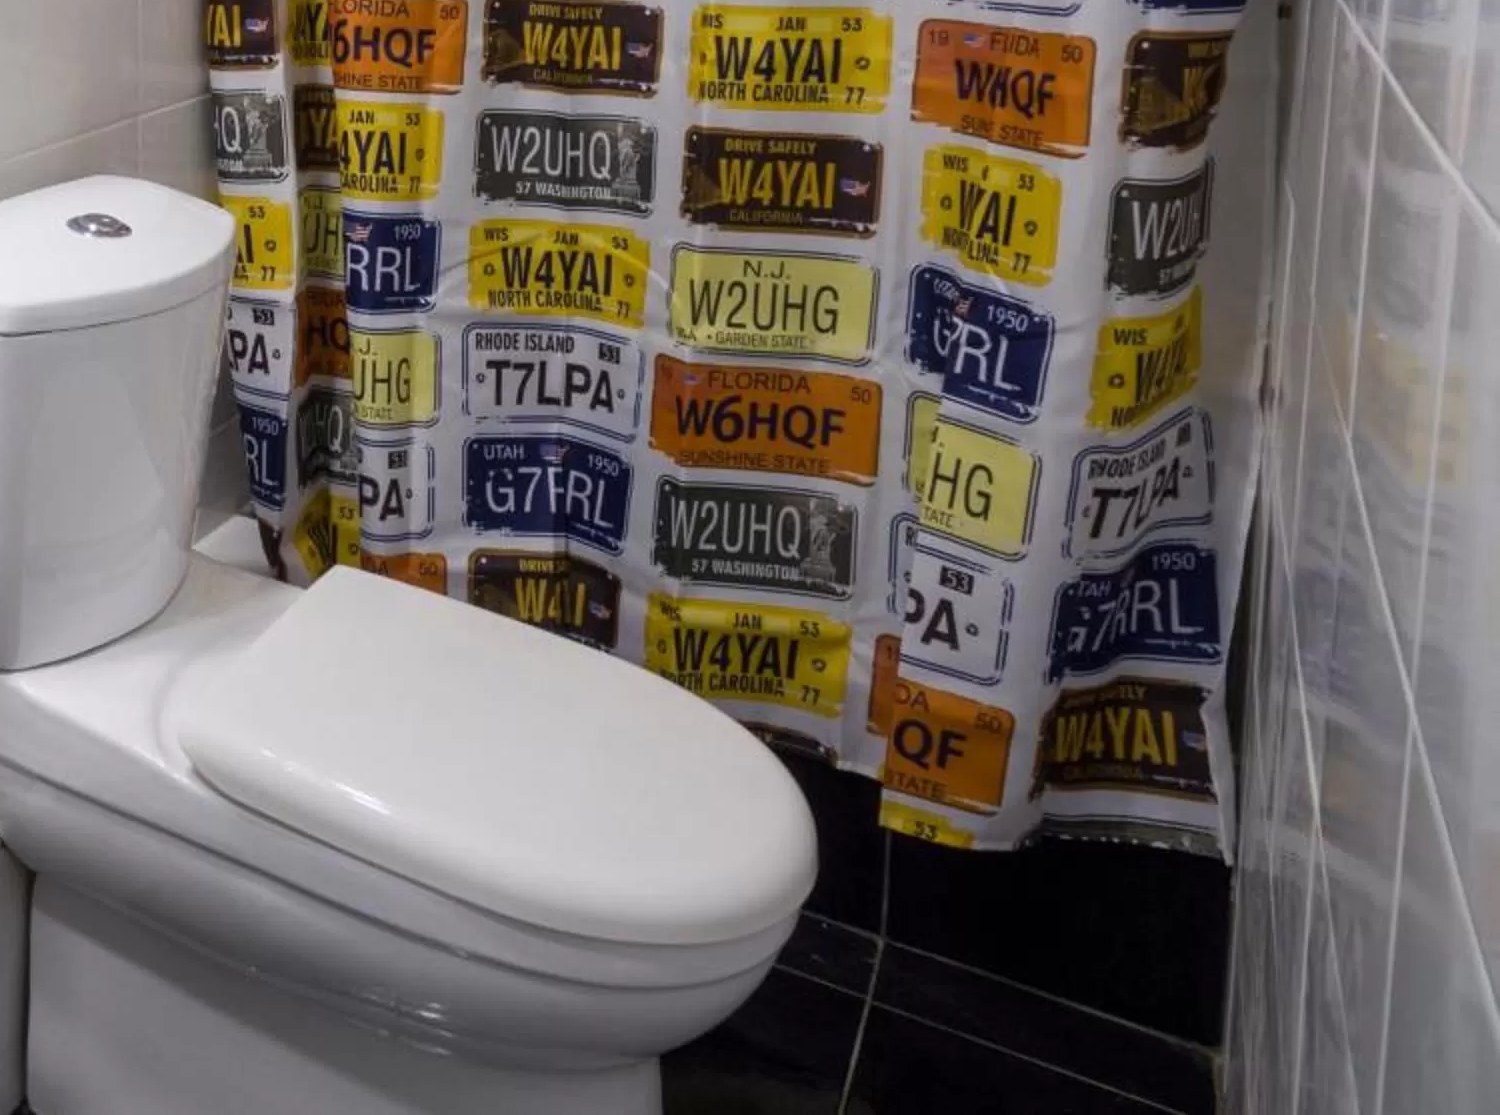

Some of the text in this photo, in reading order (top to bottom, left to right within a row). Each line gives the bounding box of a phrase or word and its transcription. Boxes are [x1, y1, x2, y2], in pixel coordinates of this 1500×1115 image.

[439, 4, 460, 22] 50
[775, 15, 863, 32] JAN 53
[522, 20, 622, 66] W4YAI
[1059, 42, 1084, 63] 50
[713, 35, 843, 86] W4YAI
[378, 75, 425, 91] STATE
[752, 83, 830, 105] CAROLINA
[843, 86, 866, 105] 77
[347, 109, 422, 127] JAN 53
[998, 122, 1046, 147] STATE
[490, 124, 612, 182] W2UHQ
[718, 157, 837, 210] W4YAI
[942, 152, 1036, 191] WIS 53
[515, 180, 531, 195] 57
[248, 205, 267, 221] 53
[484, 226, 629, 252] WIS JAN 53
[260, 266, 277, 283] 77
[500, 246, 614, 298] W4YAI
[741, 259, 792, 280] N.J.
[487, 288, 632, 319] NORTH CAROLINA 77
[688, 277, 841, 335] W2UHG
[986, 303, 1029, 334] 1950
[474, 331, 576, 355] RHODE ISLAND
[715, 330, 808, 350] GARDEN STATE
[1113, 327, 1147, 347] WIS
[485, 359, 615, 415] T7LPA
[706, 370, 872, 406] FLORIDA 50
[675, 394, 848, 450] W6HQF
[483, 443, 620, 480] UTAH 1950
[772, 453, 831, 474] STATE
[669, 494, 801, 561] W2UHQ
[691, 559, 801, 582] 57 WASHINGTON
[1151, 552, 1197, 572] 1950
[945, 569, 971, 594] 53
[731, 612, 821, 637] JAN 53
[672, 624, 801, 682] W4YAI
[708, 671, 821, 706] CAROLINA 77
